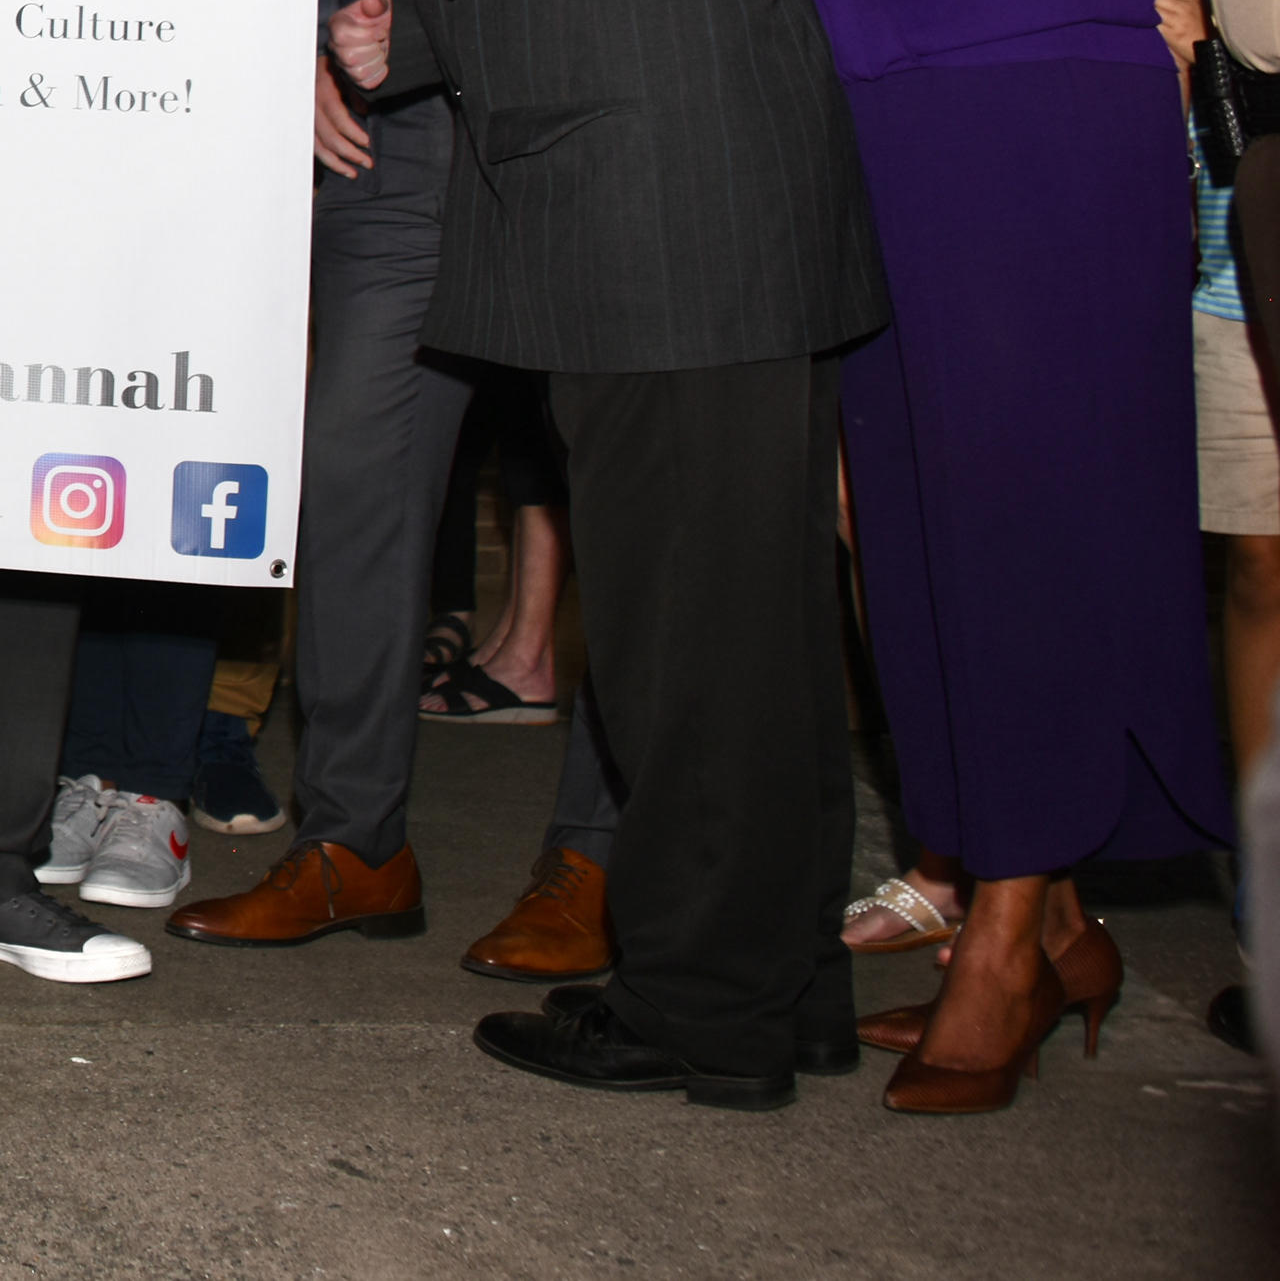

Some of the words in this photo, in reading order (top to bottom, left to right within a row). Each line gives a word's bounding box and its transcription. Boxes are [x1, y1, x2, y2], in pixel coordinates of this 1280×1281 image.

[15, 2, 175, 43] Culture
[20, 73, 56, 109] &
[74, 75, 193, 114] More!
[201, 481, 239, 549] f
